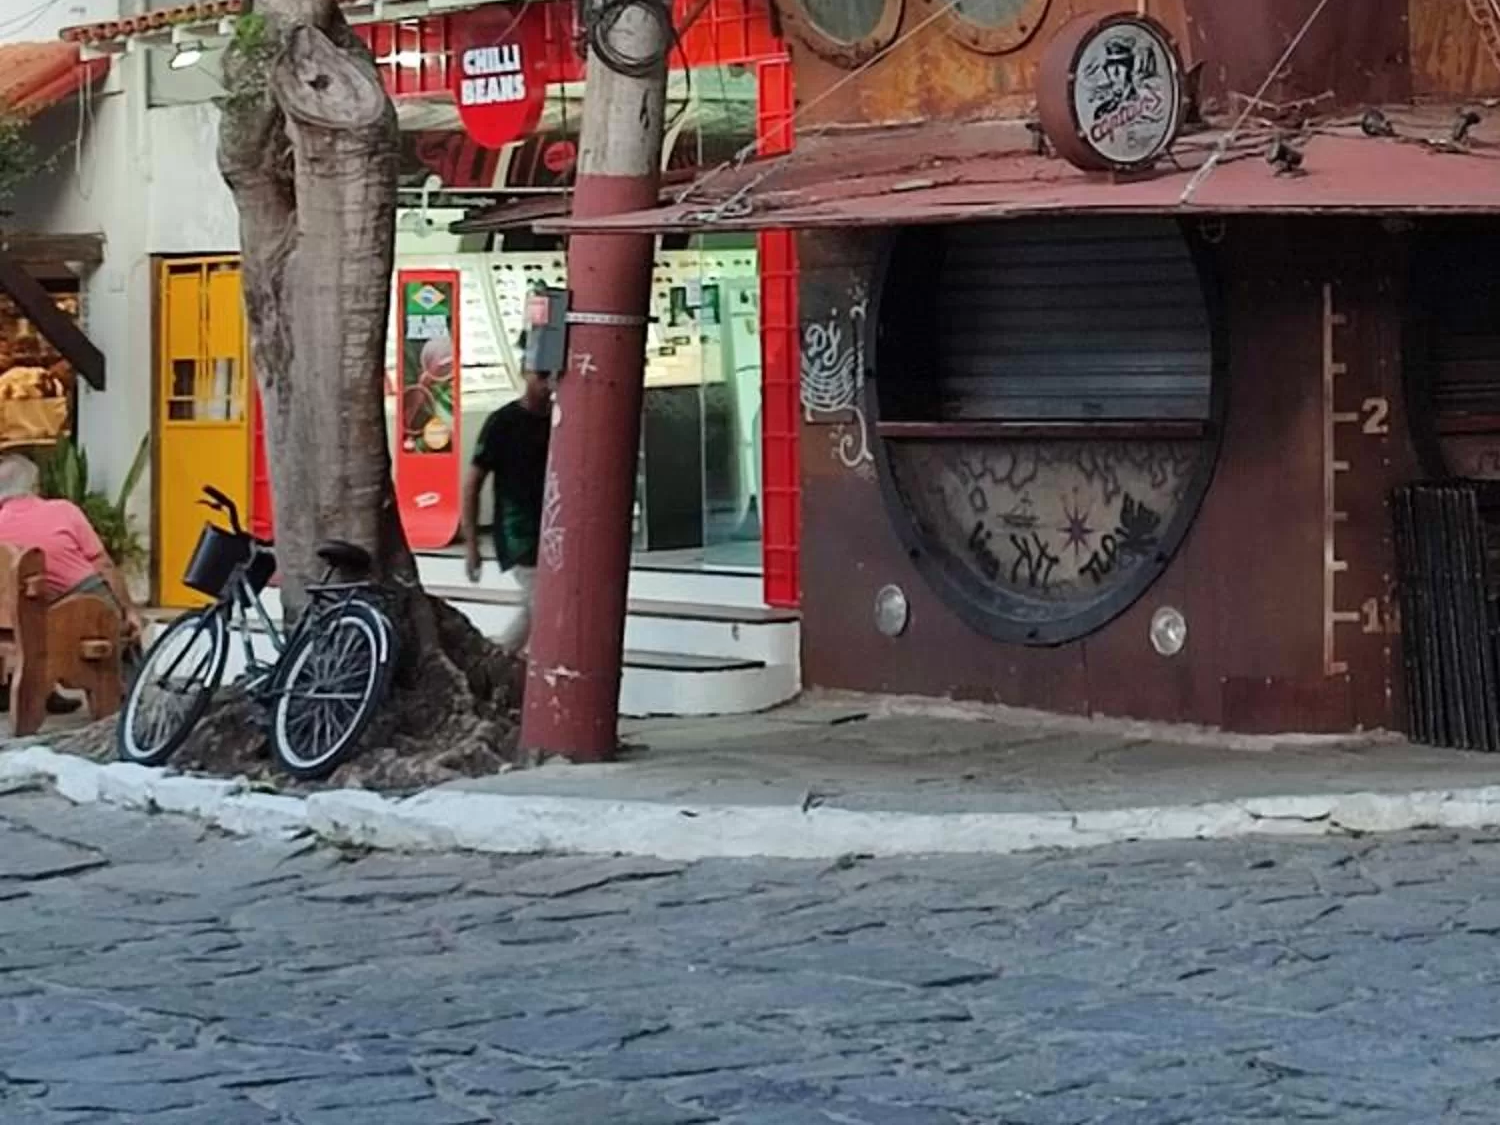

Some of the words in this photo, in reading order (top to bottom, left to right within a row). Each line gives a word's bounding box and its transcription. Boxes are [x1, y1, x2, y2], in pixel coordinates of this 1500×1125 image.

[463, 44, 521, 75] CHILLI
[461, 73, 526, 105] BEANS
[1361, 397, 1389, 435] 2
